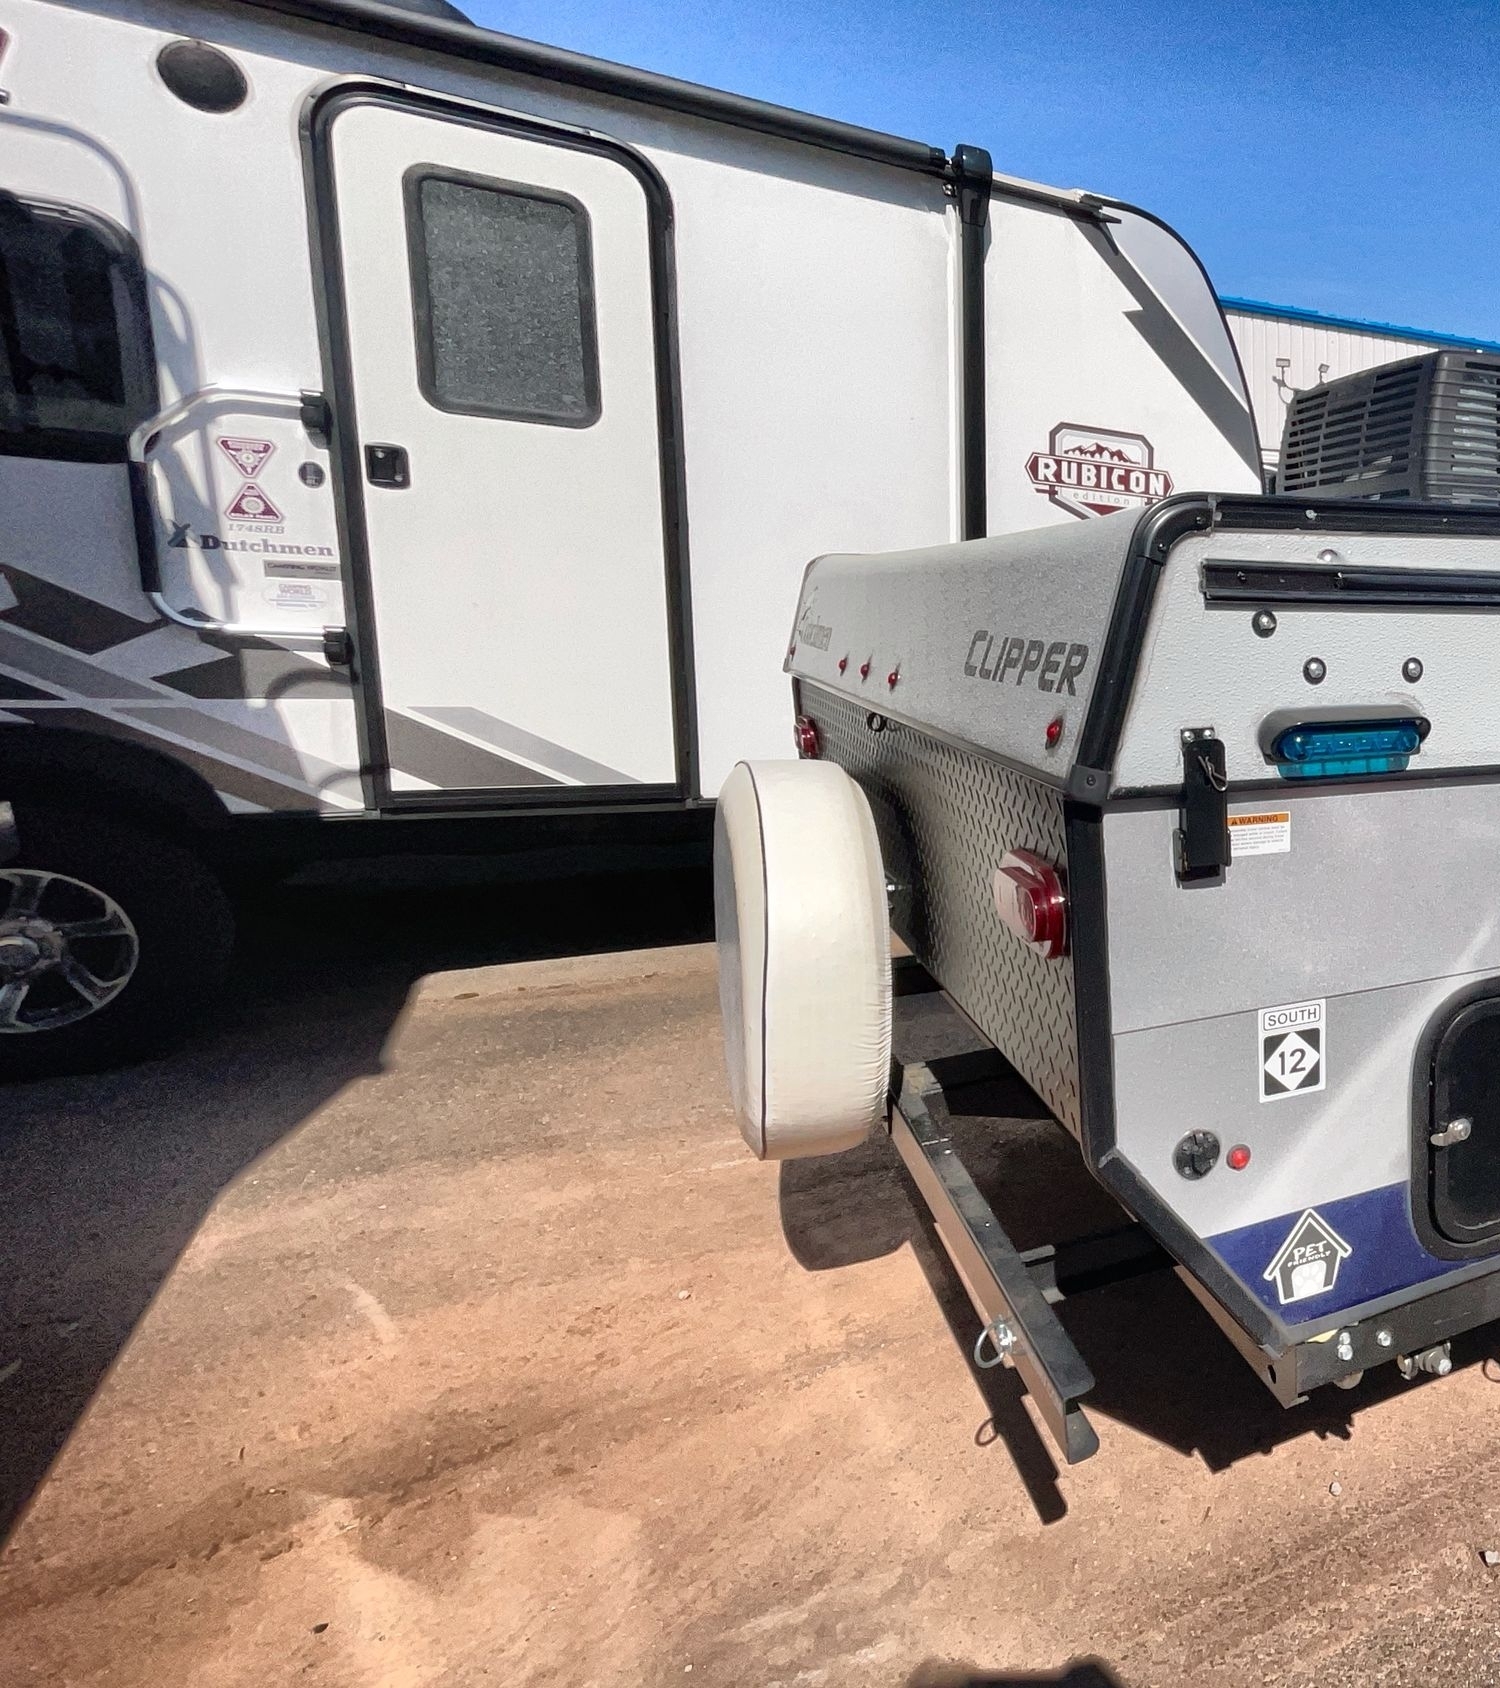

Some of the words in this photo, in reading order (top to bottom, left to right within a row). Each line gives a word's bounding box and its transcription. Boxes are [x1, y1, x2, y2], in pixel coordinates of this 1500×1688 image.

[1037, 456, 1165, 496] RUBICON
[1072, 491, 1130, 505] edition
[200, 534, 334, 557] Dutchmen
[963, 629, 1090, 697] CLIPPER
[1240, 814, 1278, 825] WARNING
[1268, 1007, 1317, 1027] SOUTH
[1278, 1047, 1307, 1076] 12
[1293, 1240, 1327, 1262] PET
